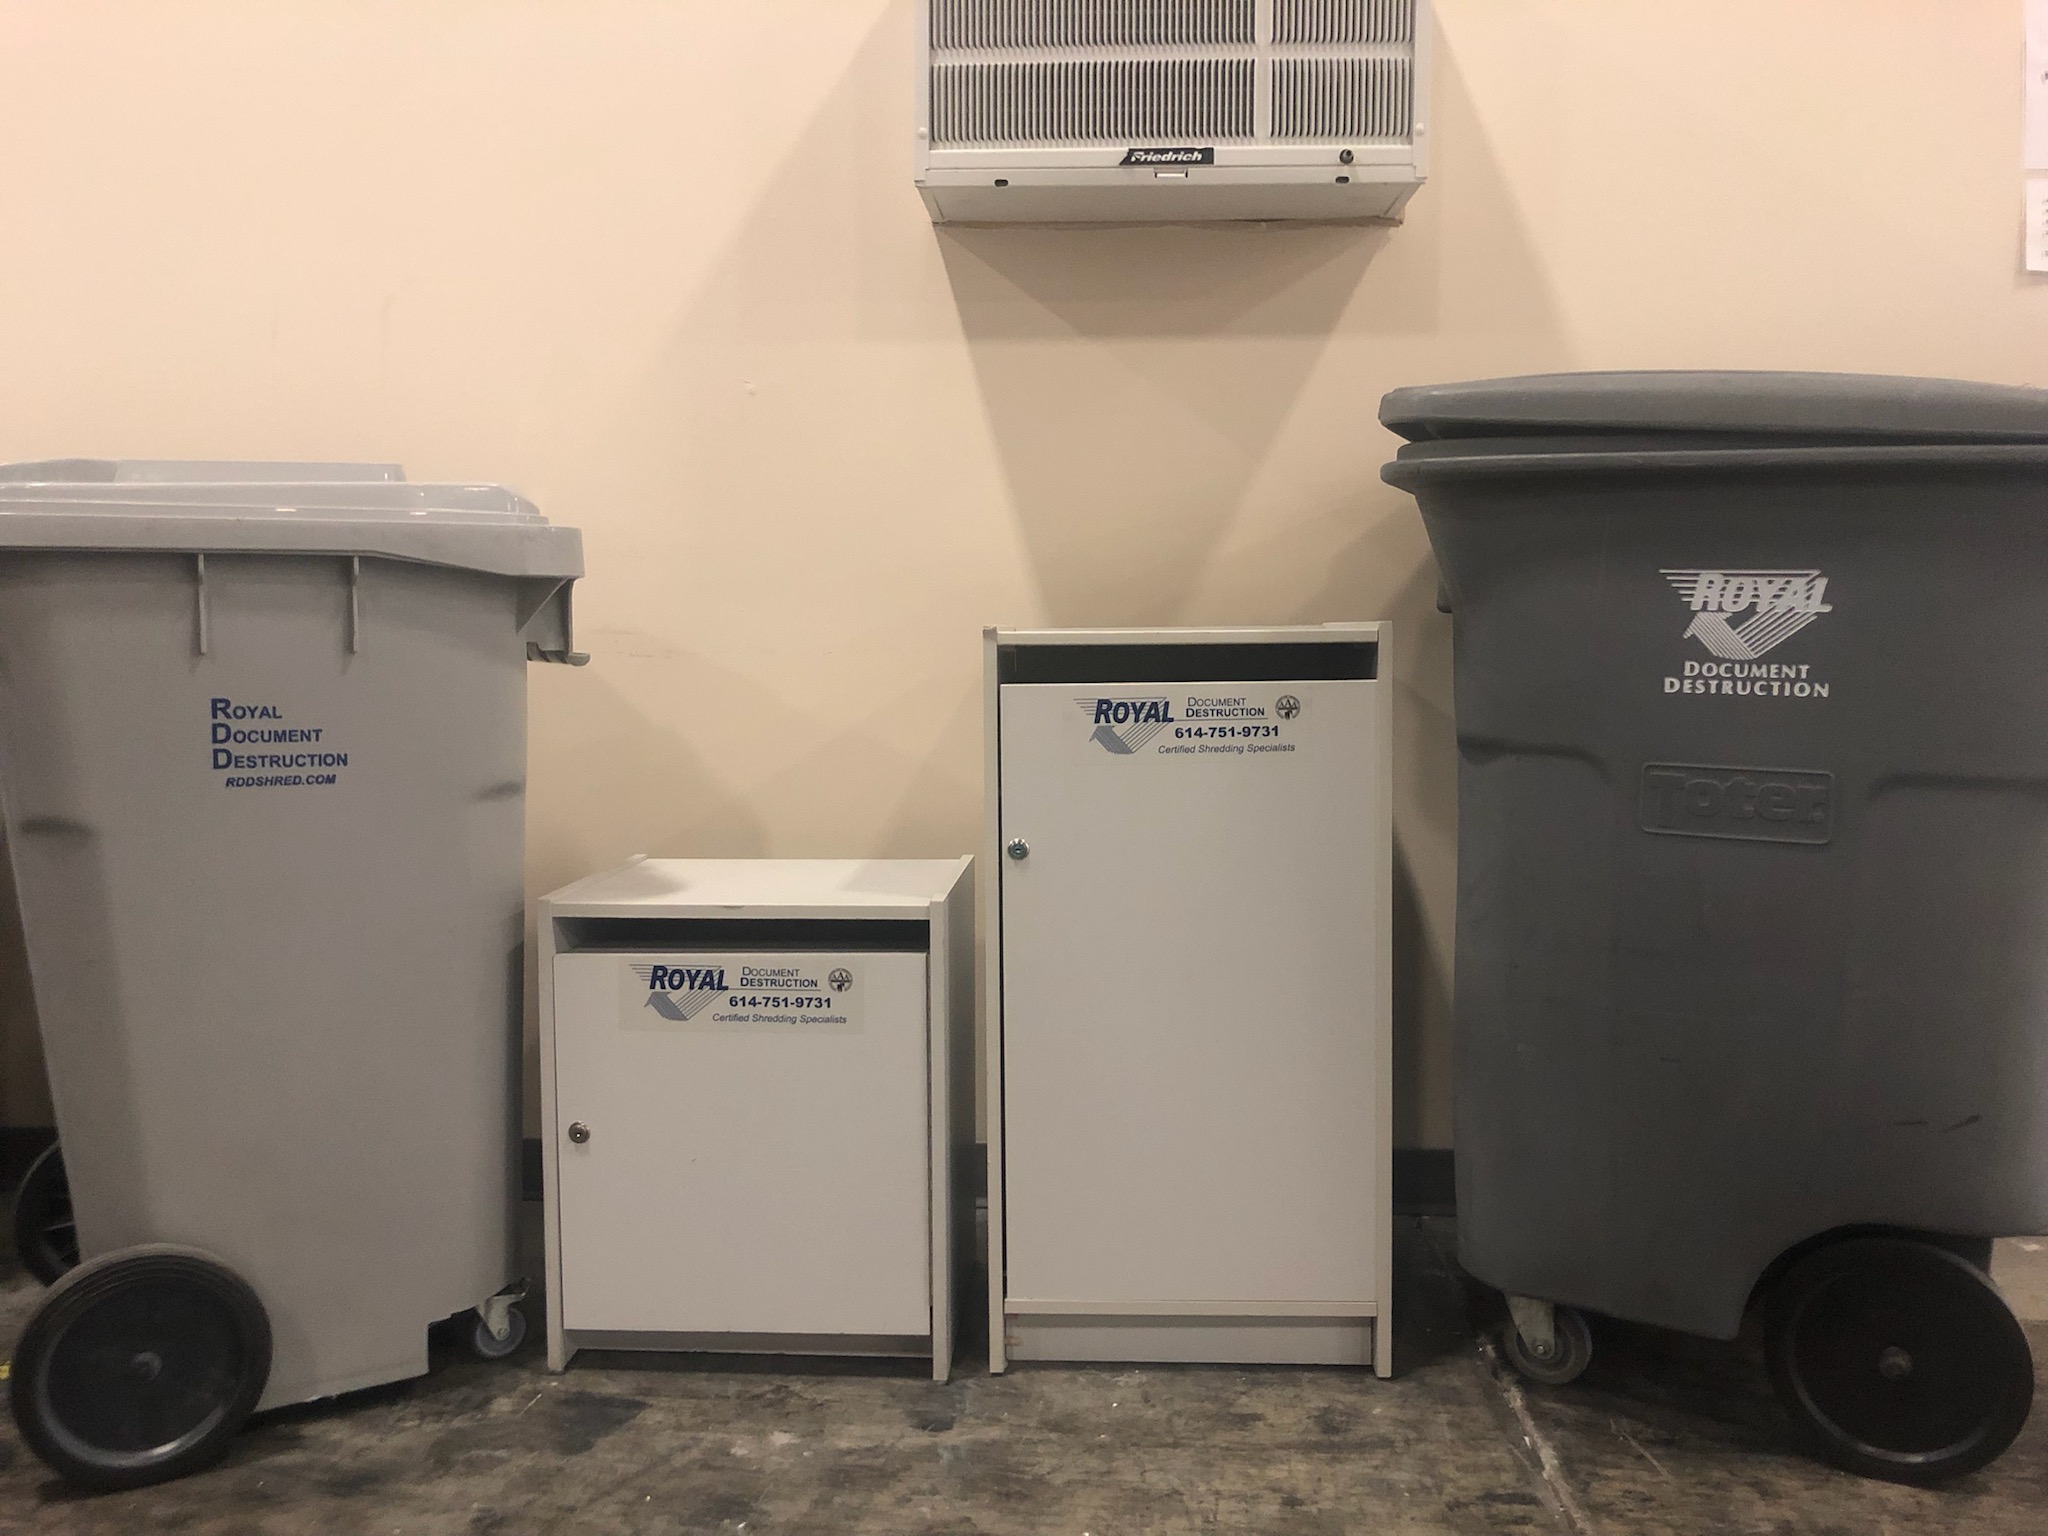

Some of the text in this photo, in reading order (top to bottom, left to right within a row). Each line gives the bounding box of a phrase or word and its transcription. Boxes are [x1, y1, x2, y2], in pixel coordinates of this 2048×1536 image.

[1130, 151, 1203, 162] Friedrich
[1690, 573, 1833, 613] ROYAL
[1683, 660, 1810, 679] DOCUMENT
[1664, 677, 1829, 697] DESTRUCTION
[211, 698, 283, 720] ROYAL
[1187, 697, 1247, 707] DOCUMENT
[1094, 699, 1174, 724] ROYAL
[1186, 707, 1265, 718] DESTRUCTION
[211, 723, 323, 744] DOCUMENT
[1174, 725, 1280, 739] 614-751-9731
[1158, 743, 1296, 755] Certified Shredding Specialists
[212, 748, 348, 769] DESTRUCTION
[225, 774, 337, 788] RDDSHRED.COM
[649, 965, 729, 991] ROYAL
[742, 966, 800, 977] DOCUMENT
[740, 977, 818, 988] DESTRUCTION
[728, 995, 832, 1009] 614-751-9731
[712, 1013, 848, 1025] Certified Shredding Specialists
